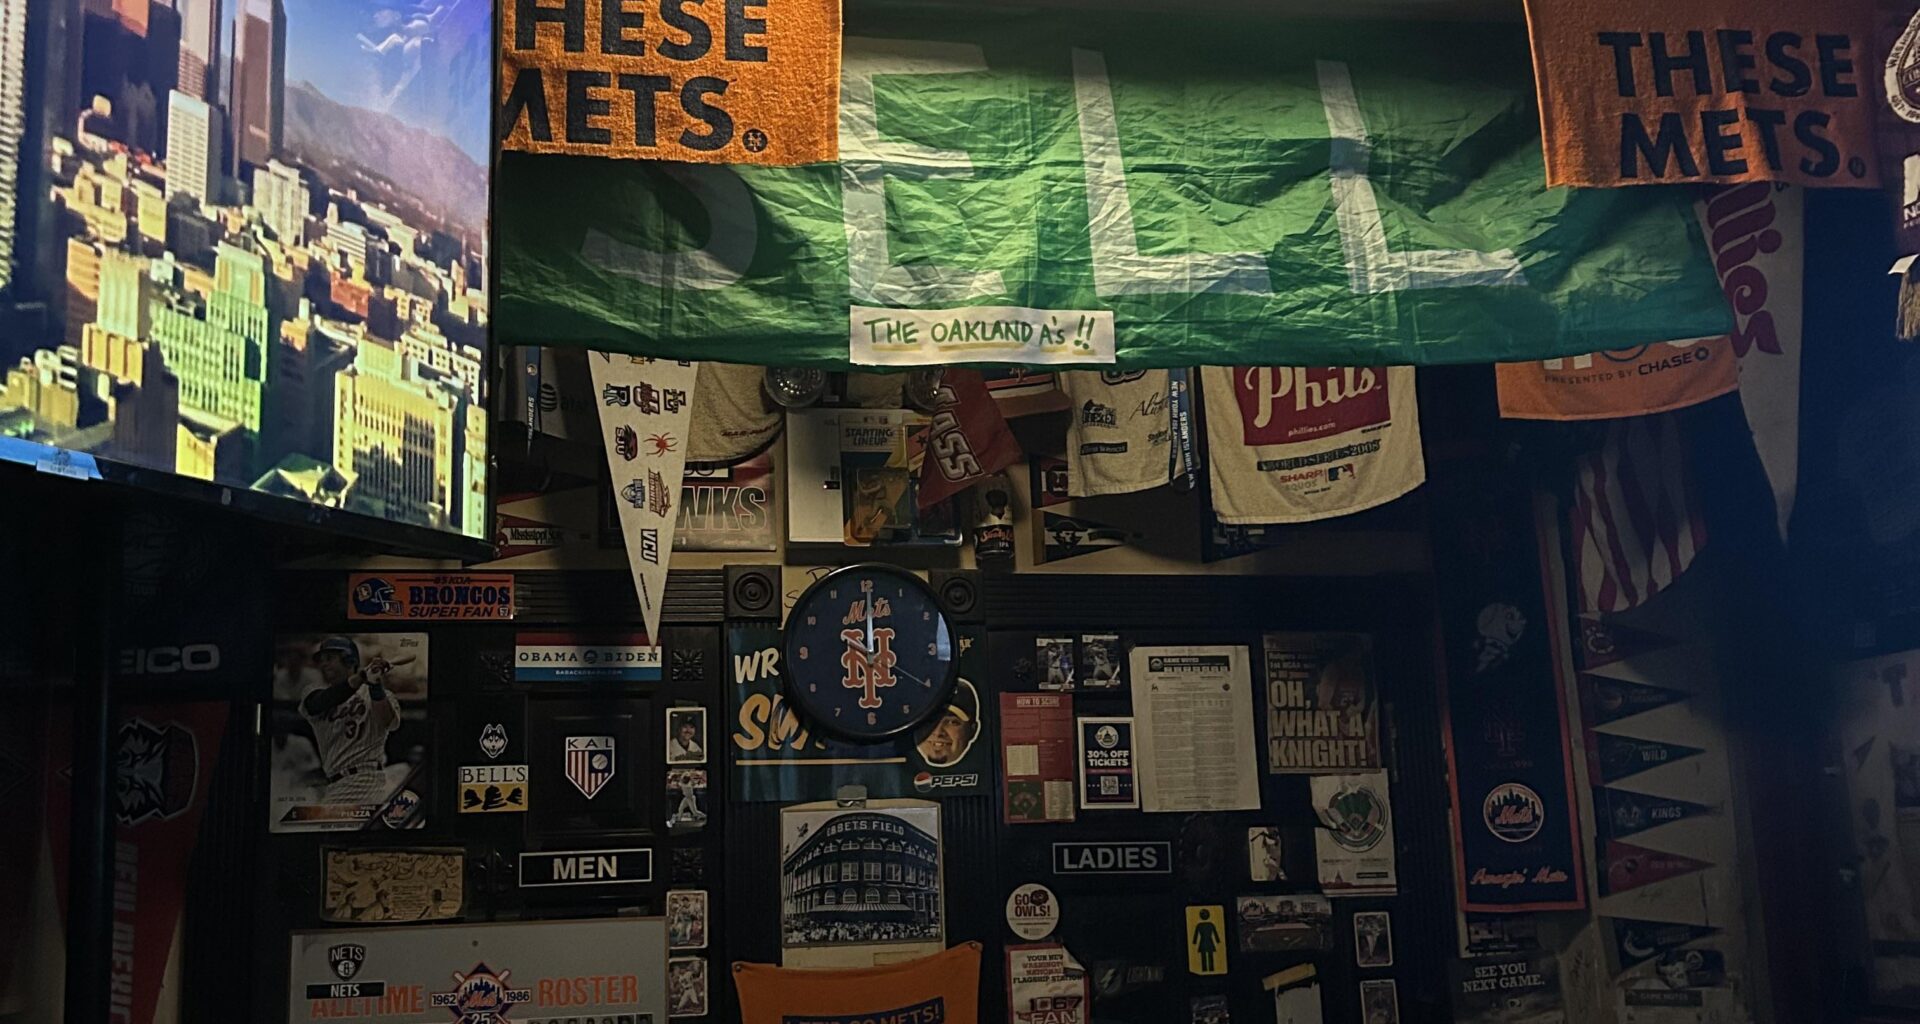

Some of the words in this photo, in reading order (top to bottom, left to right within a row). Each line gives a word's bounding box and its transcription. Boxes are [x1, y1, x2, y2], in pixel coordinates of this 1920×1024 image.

[1599, 28, 1858, 98] THESE
[863, 317, 919, 344] THE
[931, 318, 1033, 343] OAKLAND
[1543, 373, 1613, 385] PRESENTED
[1618, 369, 1634, 379] BY
[1637, 351, 1692, 376] CHASE
[846, 428, 893, 438] STARTING
[1288, 422, 1336, 437] phillies.com
[853, 437, 887, 447] LINEUP
[1280, 470, 1323, 482] SHARP
[641, 529, 658, 564] VCU
[860, 580, 874, 592] 12
[408, 586, 510, 605] BRONCOS
[408, 606, 458, 618] SUPER
[462, 606, 493, 617] FAN
[520, 651, 578, 662] OBAMA
[604, 651, 659, 662] BIDEN
[928, 643, 937, 656] 3
[1270, 680, 1312, 709] OH,
[1271, 709, 1340, 737] WHAT
[1349, 711, 1365, 737] A
[1271, 739, 1369, 767] KNIGHT!
[1641, 750, 1667, 761] WILD
[1088, 758, 1130, 767] TICKETS
[462, 767, 526, 783] BELL'S
[931, 774, 978, 787] PEPSI
[1651, 806, 1682, 819] KINGS
[872, 820, 905, 835] FIELD
[1063, 846, 1159, 870] LADIES
[553, 855, 618, 881] MEN
[1014, 893, 1030, 906] GO
[1014, 905, 1051, 917] OWLS!
[331, 946, 363, 962] NETS
[1027, 954, 1047, 962] YOUR
[1474, 965, 1498, 978] SEE
[1499, 962, 1527, 975] YOU
[1013, 975, 1050, 984] FLAGSHIP
[1051, 974, 1082, 982] STATION
[1463, 978, 1498, 993] NEXT
[1499, 974, 1546, 989] GAME.
[330, 984, 361, 998] NETS
[505, 990, 531, 1002] 1986
[538, 975, 639, 1007] ROSTER
[432, 994, 457, 1006] 1962
[1030, 1010, 1077, 1024] FAN
